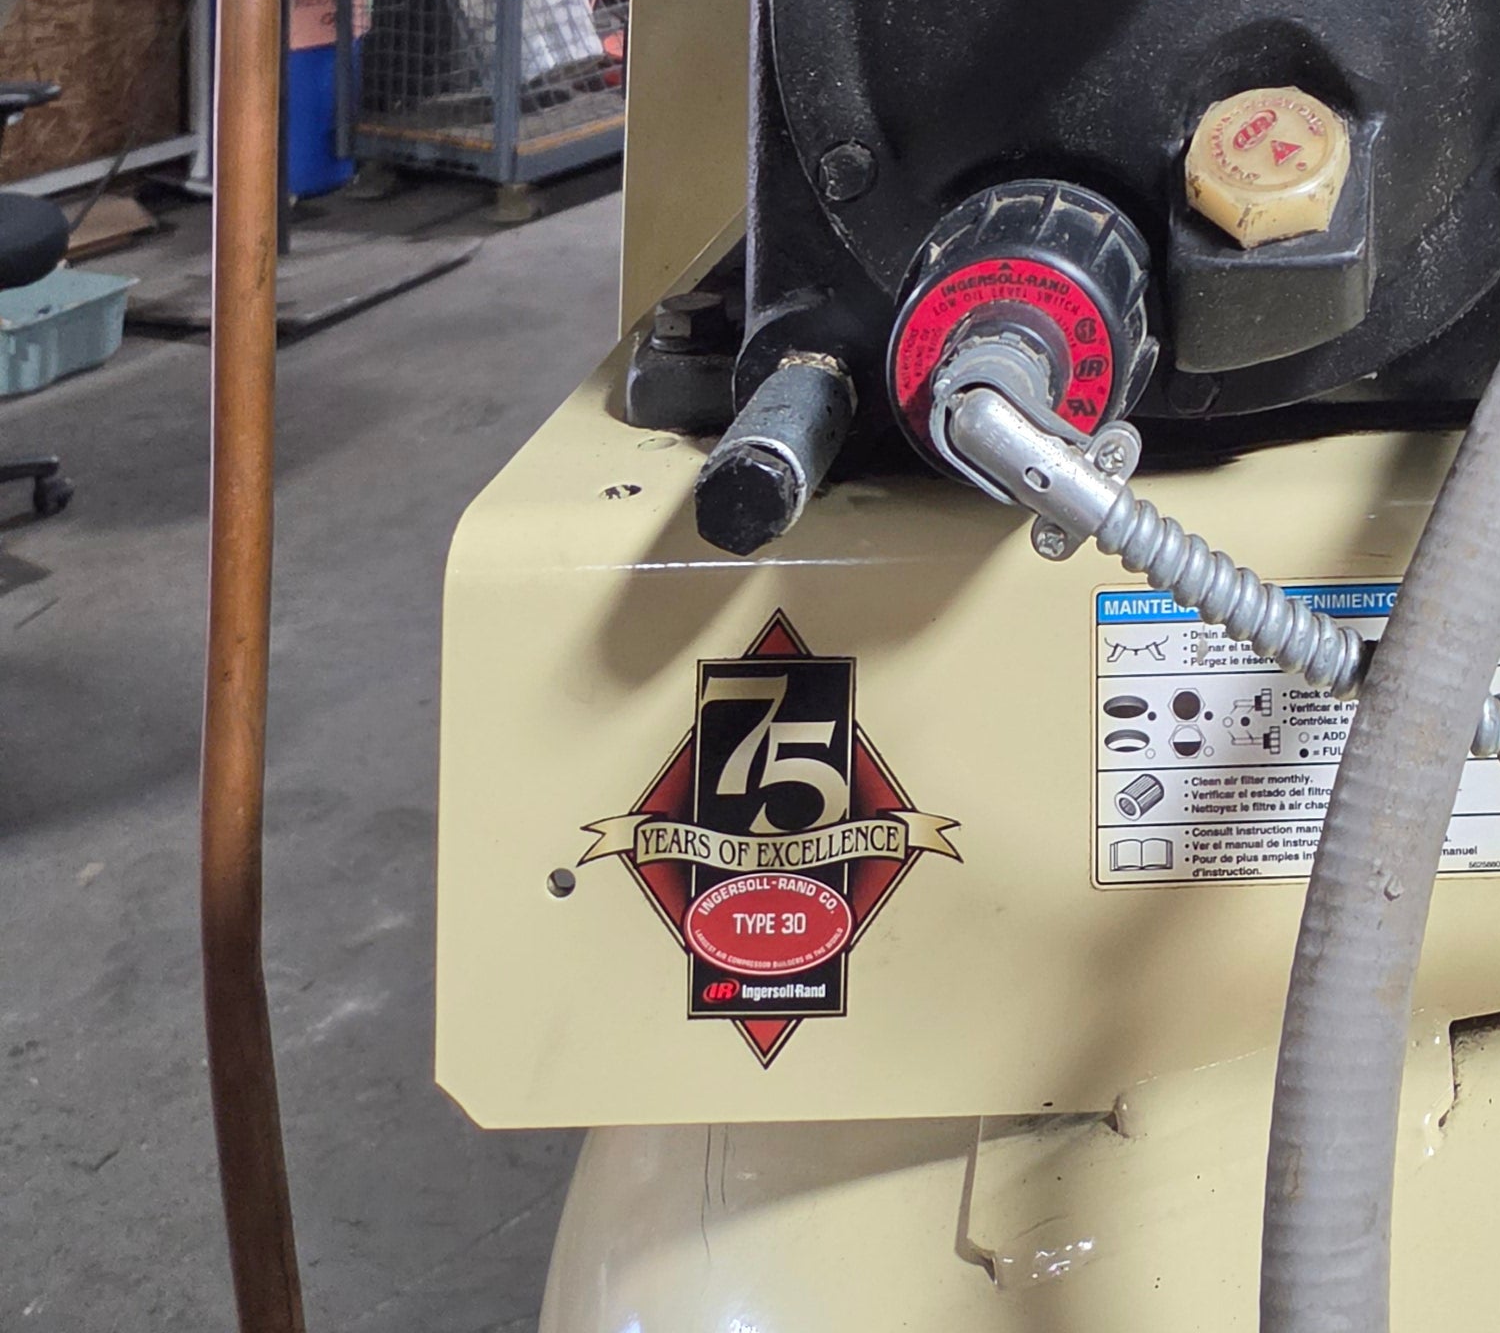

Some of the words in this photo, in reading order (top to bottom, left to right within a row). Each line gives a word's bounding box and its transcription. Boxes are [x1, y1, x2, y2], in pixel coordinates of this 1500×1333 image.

[932, 300, 957, 316] LOW
[963, 290, 984, 303] OIL
[992, 285, 1027, 298] LEVEL
[1037, 290, 1080, 315] SWITCH
[1104, 599, 1199, 616] MAINTEN
[1285, 593, 1398, 609] ENIMIENTO
[1242, 655, 1276, 665] réserv
[1289, 689, 1321, 699] Check
[1289, 702, 1331, 713] Verificar
[1334, 702, 1343, 711] el
[1289, 715, 1338, 726] Contrôlez
[1340, 716, 1349, 724] le
[1322, 732, 1347, 741] ADD
[702, 673, 849, 832] 75
[1323, 746, 1342, 756] FUL
[1191, 776, 1222, 786] Clean
[1224, 775, 1238, 785] air
[1241, 775, 1265, 785] filter
[1268, 774, 1313, 785] monthly.
[1191, 790, 1235, 799] Verificar
[1238, 789, 1248, 798] el
[1251, 788, 1286, 798] estado
[1289, 787, 1305, 796] del
[1191, 803, 1238, 815] Nettoyez
[1240, 802, 1250, 812] le
[1253, 801, 1276, 811] filtre
[1289, 801, 1302, 810] air
[1192, 827, 1233, 837] Consult
[1236, 825, 1293, 836] instruction
[641, 828, 711, 859] YEARS
[719, 839, 750, 866] OF
[757, 826, 899, 867] EXCELLENCE
[1192, 840, 1210, 850] Ver
[1213, 839, 1222, 850] el
[1225, 839, 1264, 849] manual
[1266, 838, 1280, 847] de
[1283, 837, 1320, 847] instruc
[1192, 854, 1217, 864] Pour
[1220, 853, 1233, 863] de
[1236, 853, 1258, 864] plus
[1262, 851, 1299, 863] amples
[698, 877, 816, 915] INGERSOLL-RAND
[818, 892, 838, 915] CO.
[733, 913, 776, 934] TYPE
[781, 913, 807, 934] 30
[706, 980, 737, 1001] IR
